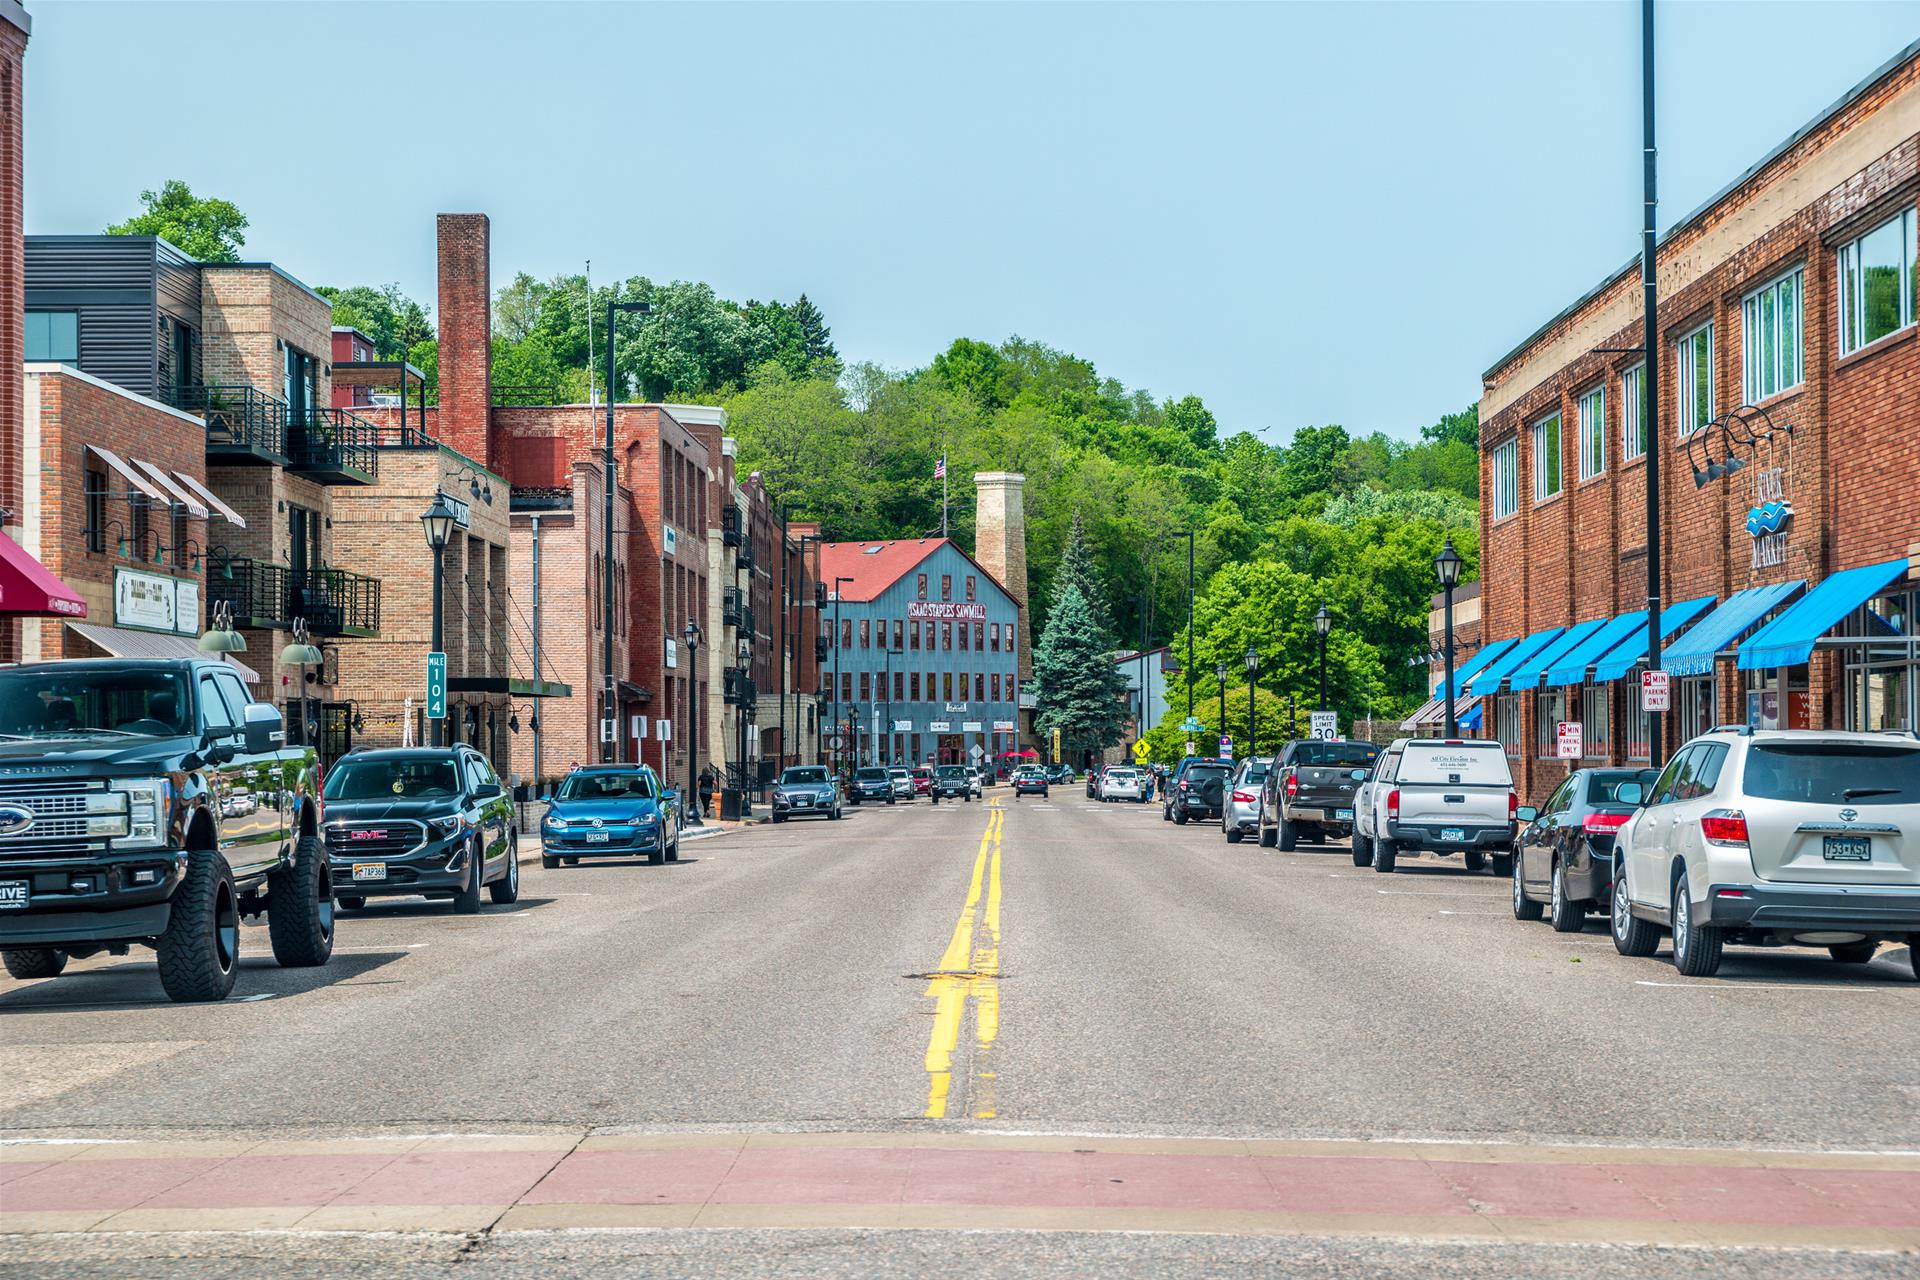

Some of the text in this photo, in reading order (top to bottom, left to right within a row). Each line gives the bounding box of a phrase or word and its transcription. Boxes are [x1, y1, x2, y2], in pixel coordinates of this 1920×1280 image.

[1752, 531, 1788, 568] MARKET
[909, 602, 985, 619] ISAAC STAPLES SAWMILL
[429, 657, 444, 666] MILE
[1643, 674, 1666, 683] 15 MIN
[1648, 697, 1664, 706] ONLY
[1314, 728, 1335, 739] 30
[1562, 746, 1577, 754] ONLY
[351, 829, 388, 840] GMC
